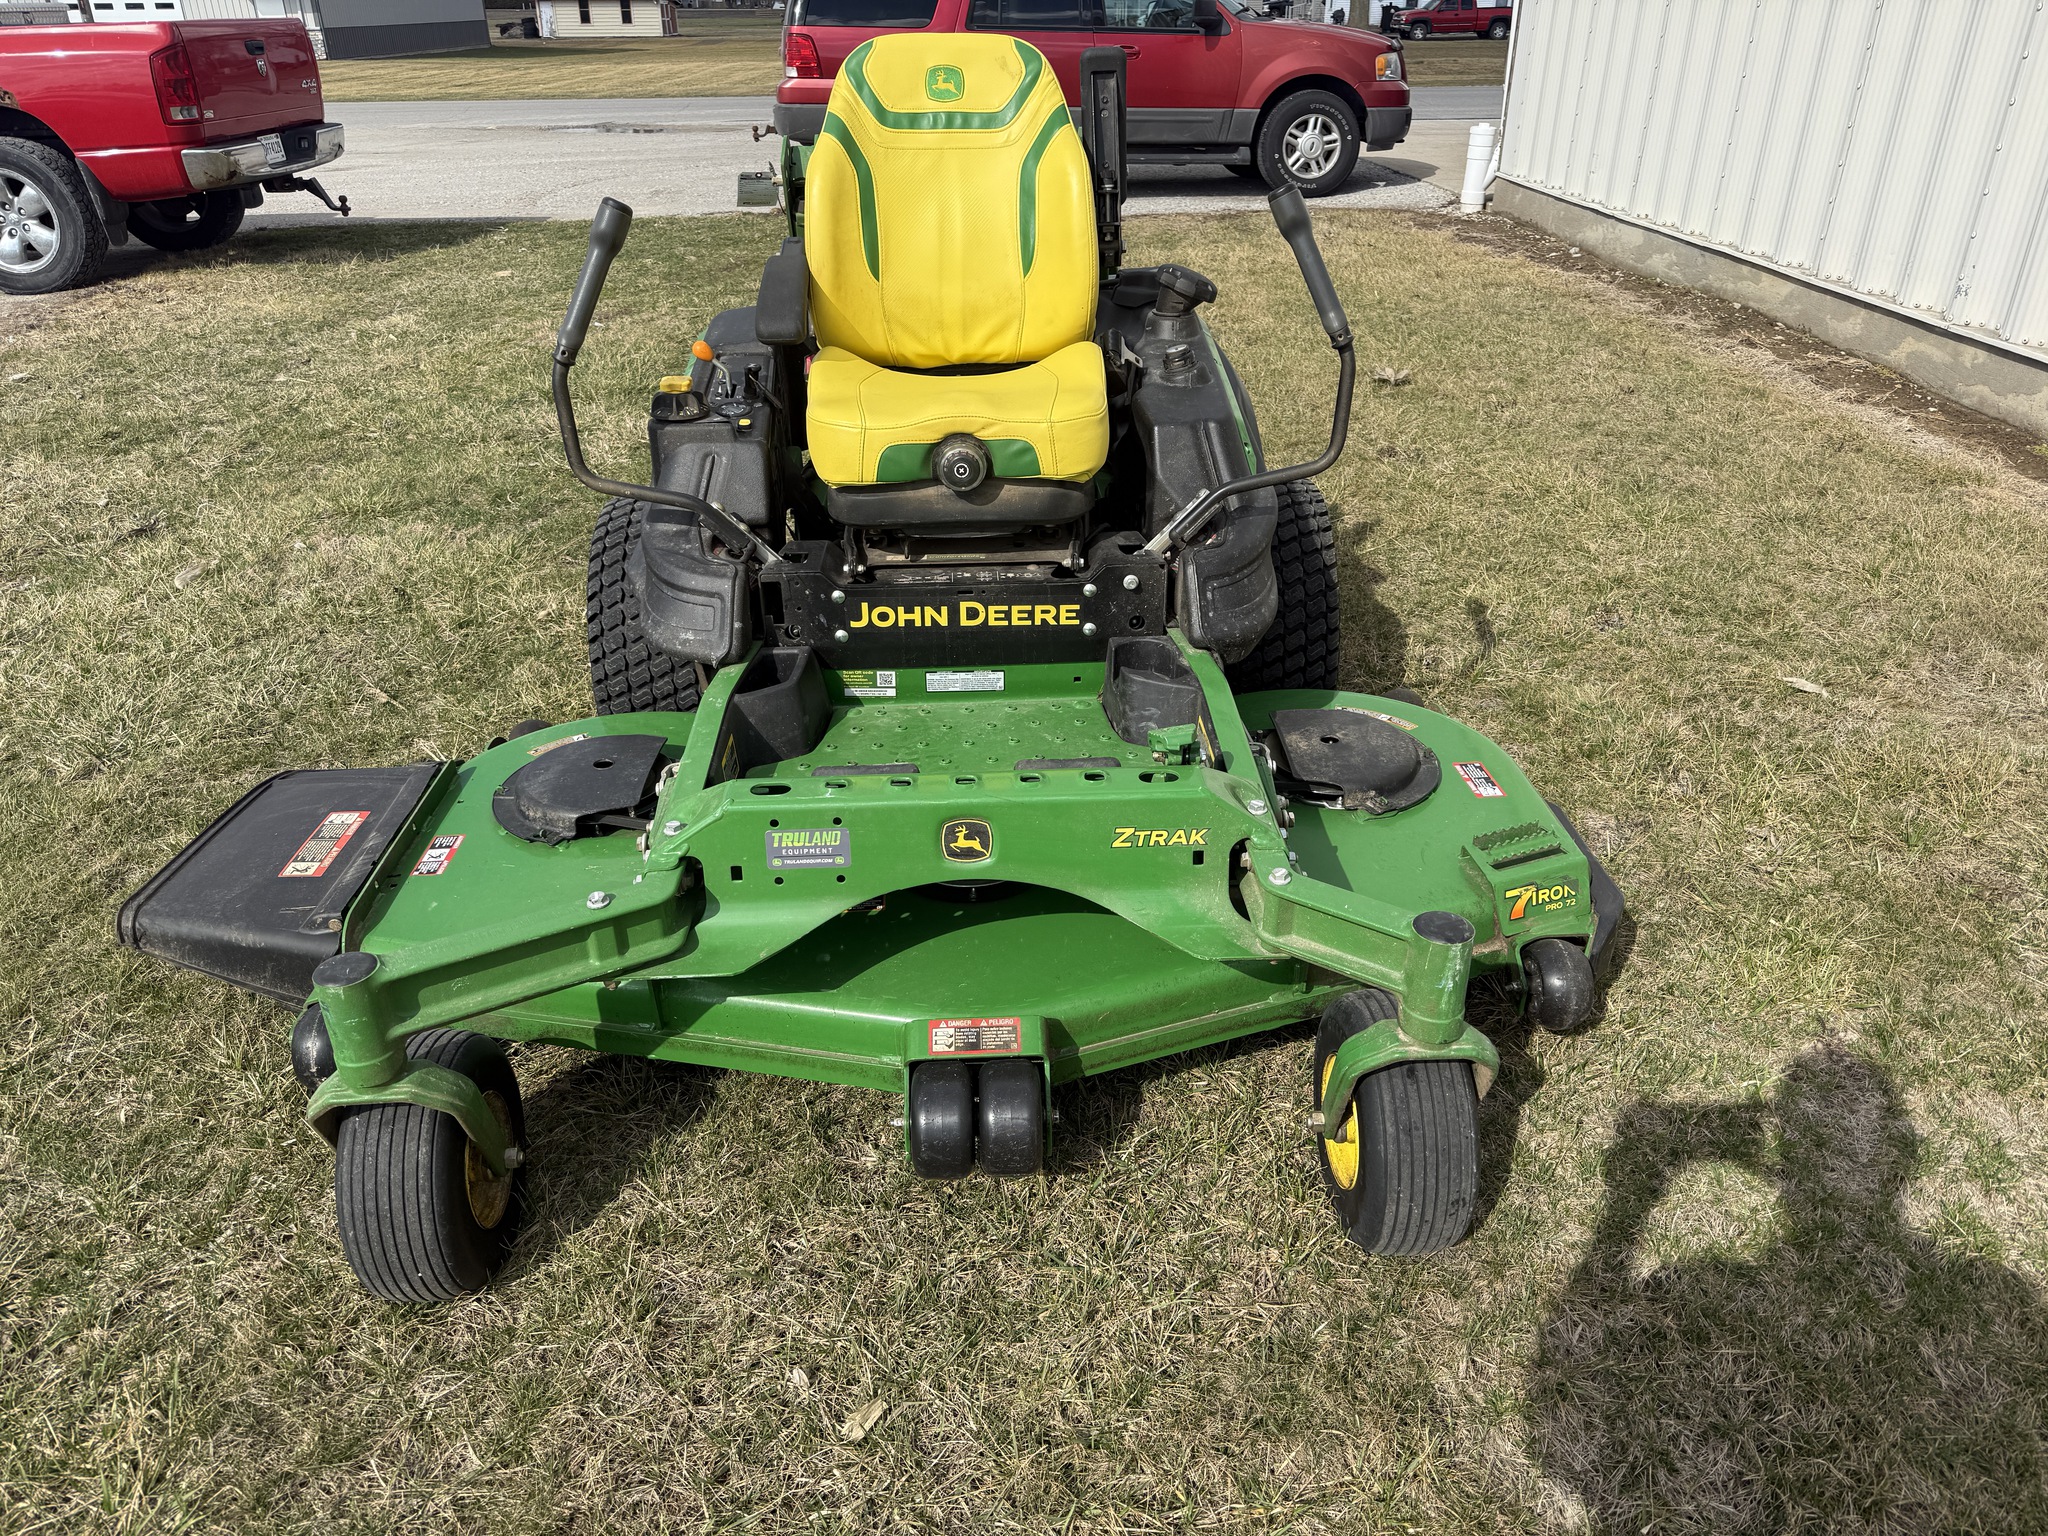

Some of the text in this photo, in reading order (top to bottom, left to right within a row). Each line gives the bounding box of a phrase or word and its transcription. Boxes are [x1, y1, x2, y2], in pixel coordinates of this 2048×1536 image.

[850, 601, 1080, 628] JOHN DEERE
[771, 830, 841, 848] TRULAND
[1111, 827, 1210, 848] ZTRAK
[782, 847, 833, 855] EQUIPMENT
[1545, 898, 1576, 912] PRO 72
